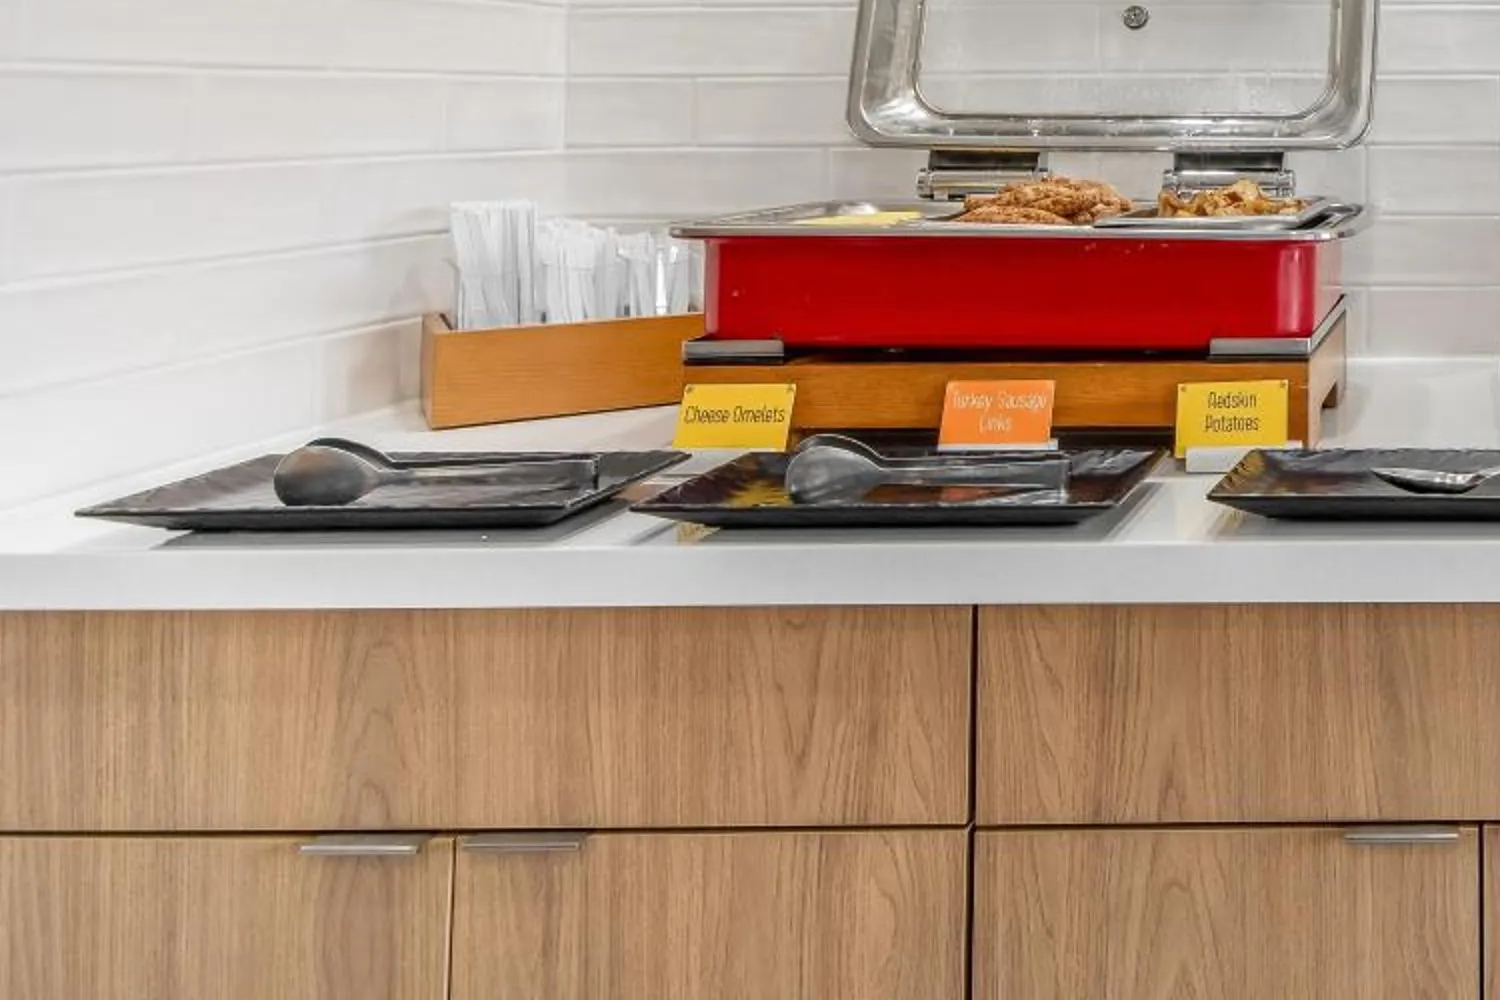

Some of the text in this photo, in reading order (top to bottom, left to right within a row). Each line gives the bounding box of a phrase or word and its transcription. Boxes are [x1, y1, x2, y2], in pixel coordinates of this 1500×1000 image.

[953, 391, 1047, 413] Turkey Sausage
[1207, 391, 1257, 409] Redskin
[683, 404, 785, 424] Cheese Omelets
[1204, 415, 1259, 433] Potatoes
